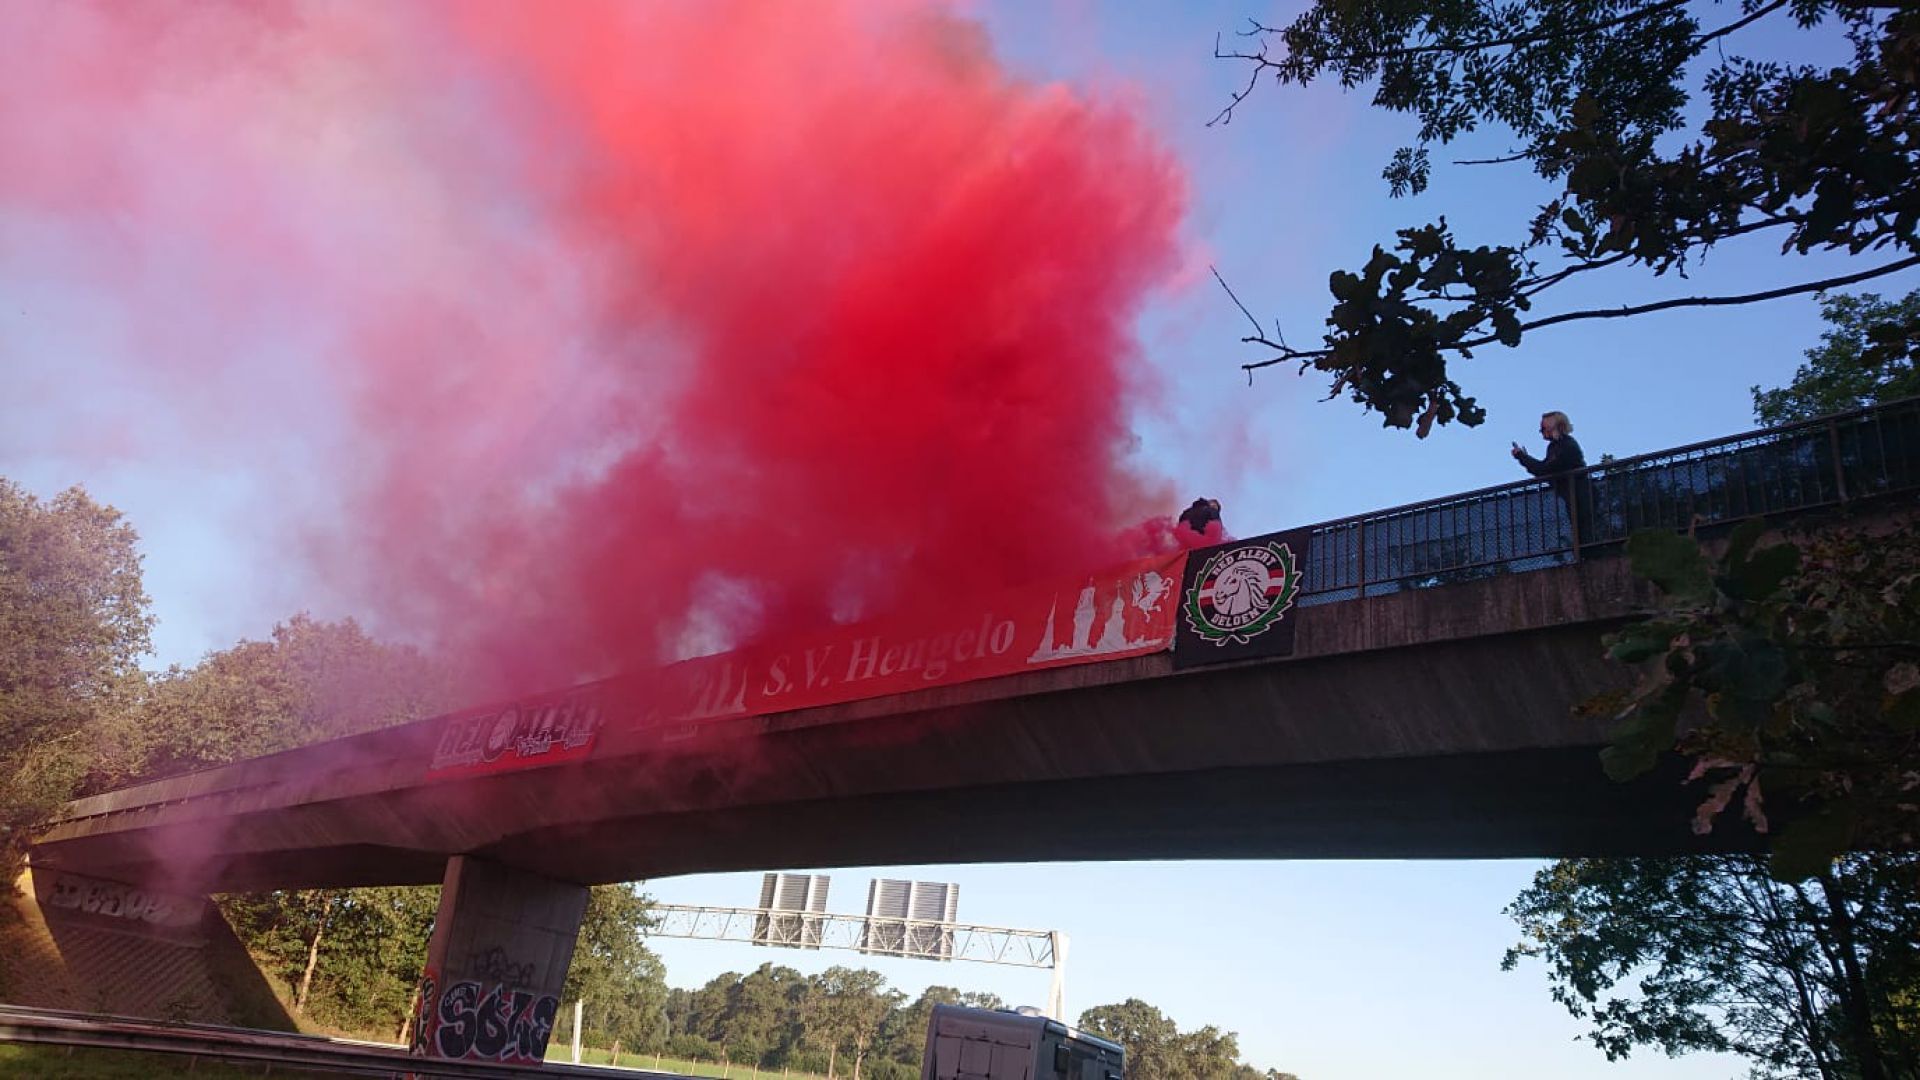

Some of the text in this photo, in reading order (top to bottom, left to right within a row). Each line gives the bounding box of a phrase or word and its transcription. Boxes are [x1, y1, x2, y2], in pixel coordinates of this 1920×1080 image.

[1212, 549, 1278, 576] RED ALERT
[842, 612, 1016, 680] Hengelo
